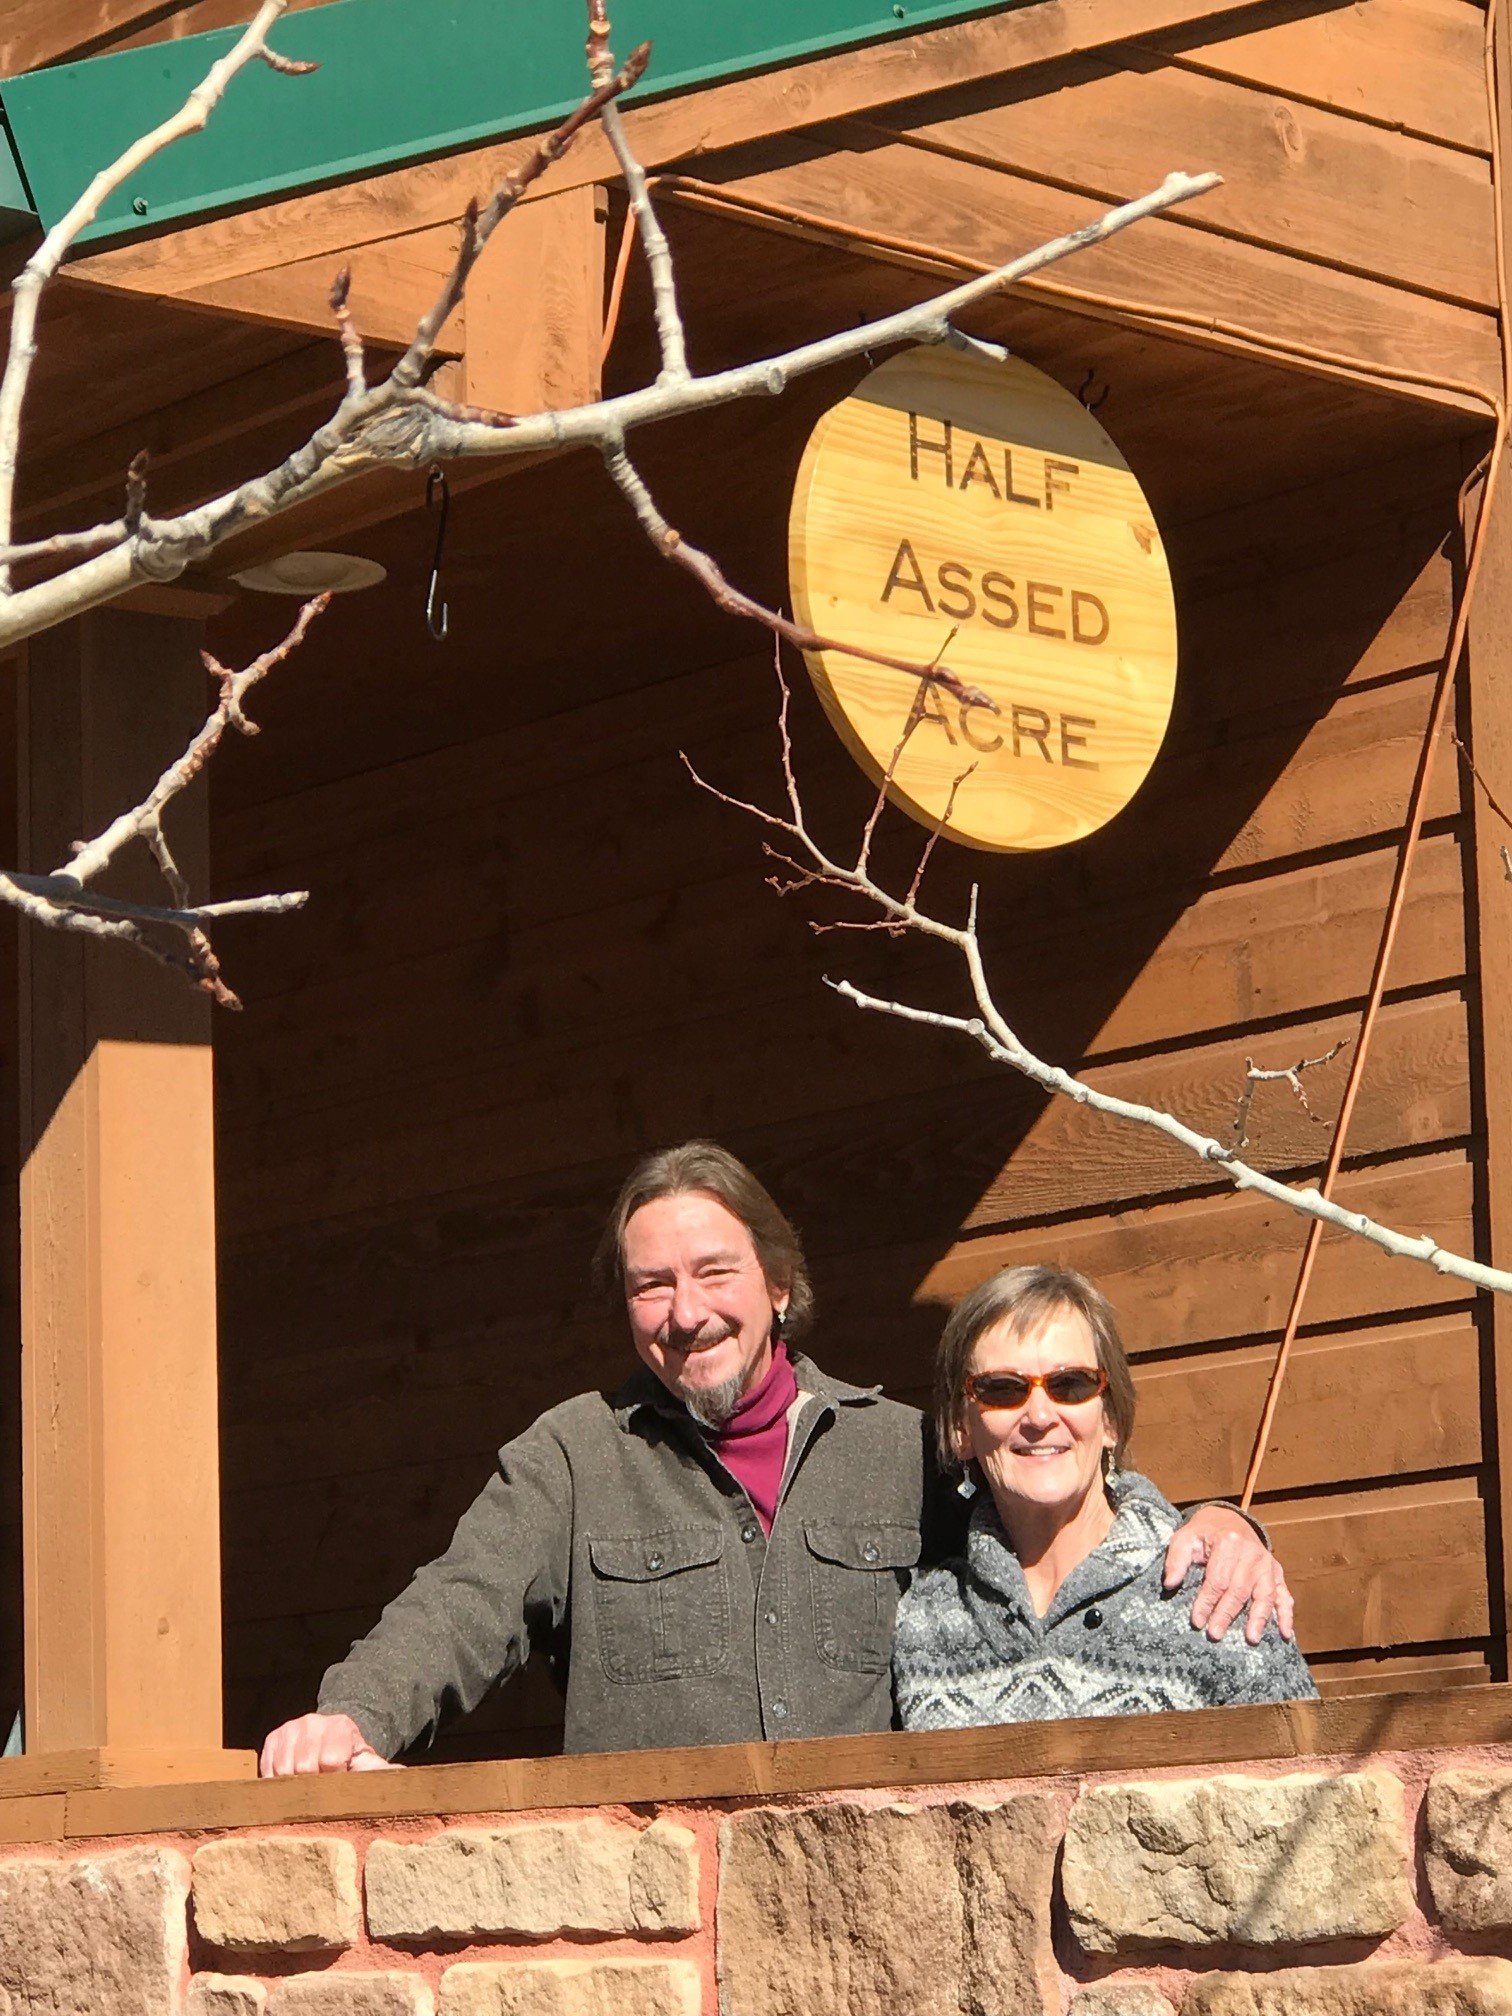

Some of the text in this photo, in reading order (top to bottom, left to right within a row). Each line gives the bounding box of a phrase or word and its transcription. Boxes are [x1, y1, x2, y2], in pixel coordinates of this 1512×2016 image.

[908, 411, 1079, 511] HALF
[880, 538, 1110, 646] ASSED
[903, 674, 1100, 771] ACRE
